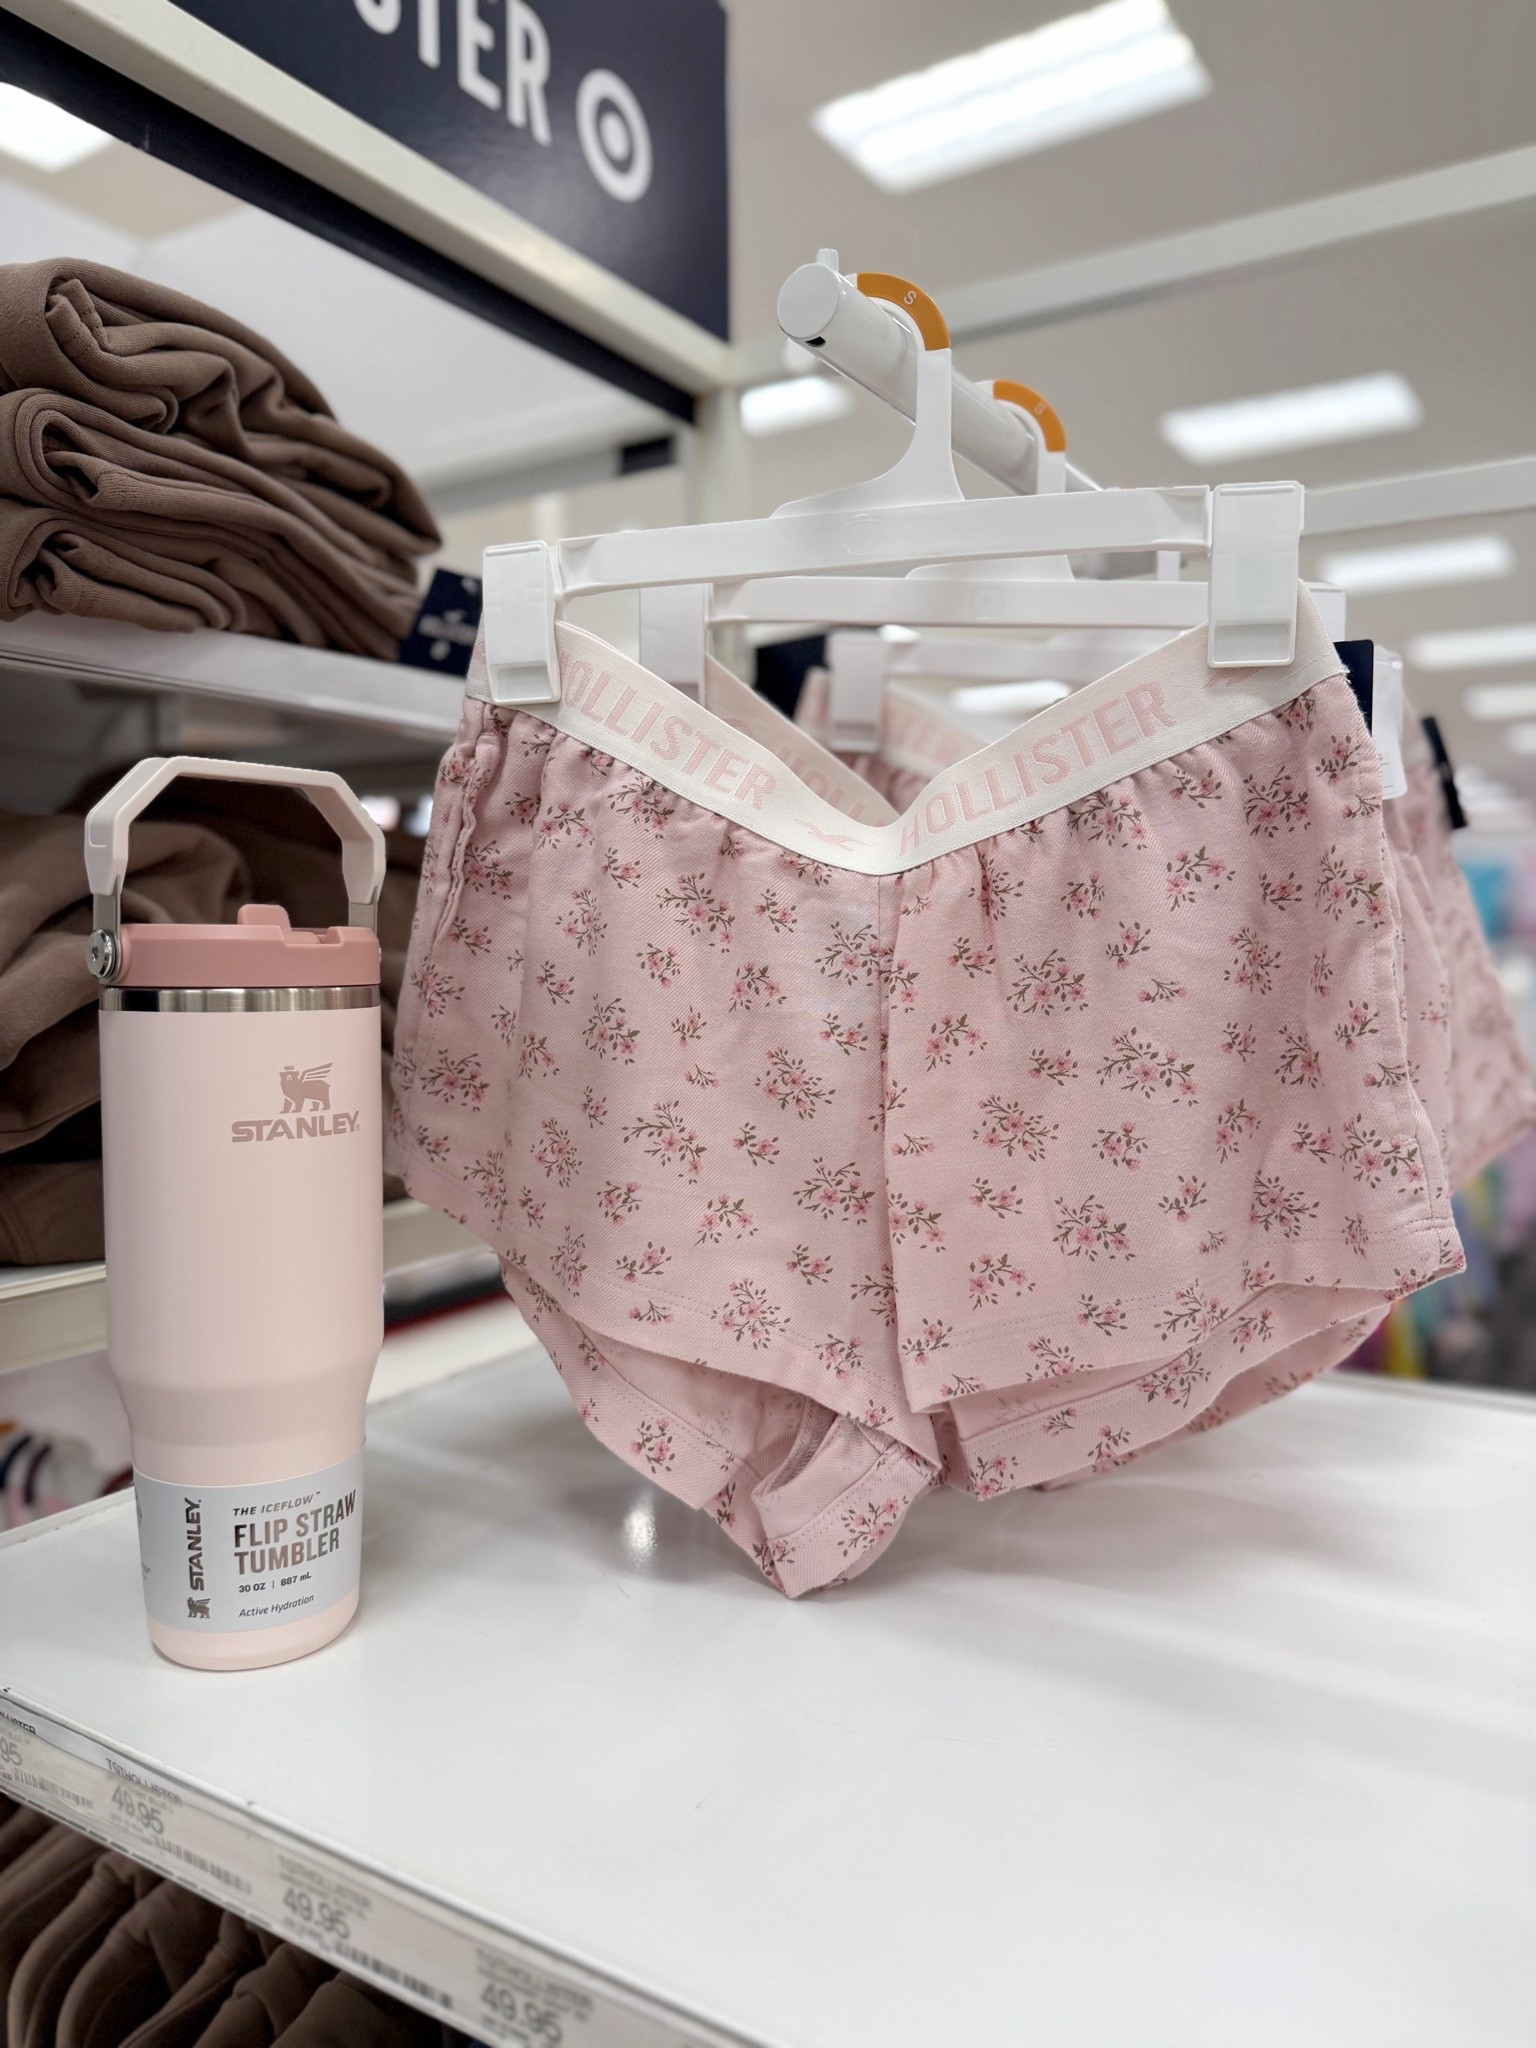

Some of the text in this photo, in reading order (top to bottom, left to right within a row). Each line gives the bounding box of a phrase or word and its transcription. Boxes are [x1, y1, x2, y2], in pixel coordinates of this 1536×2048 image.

[904, 290, 917, 305] S
[899, 680, 1177, 857] HOLLISTER
[231, 1110, 360, 1143] STANLEY
[233, 1493, 314, 1517] THE ICEFLOW
[234, 1488, 356, 1548] FLIP STRAW
[185, 1497, 204, 1591] STANLEY
[233, 1527, 340, 1575] TUMBLER
[238, 1571, 312, 1593] 30 OZ 887 mL
[238, 1594, 315, 1618] Active Hydration
[284, 1887, 350, 1939] 49.95
